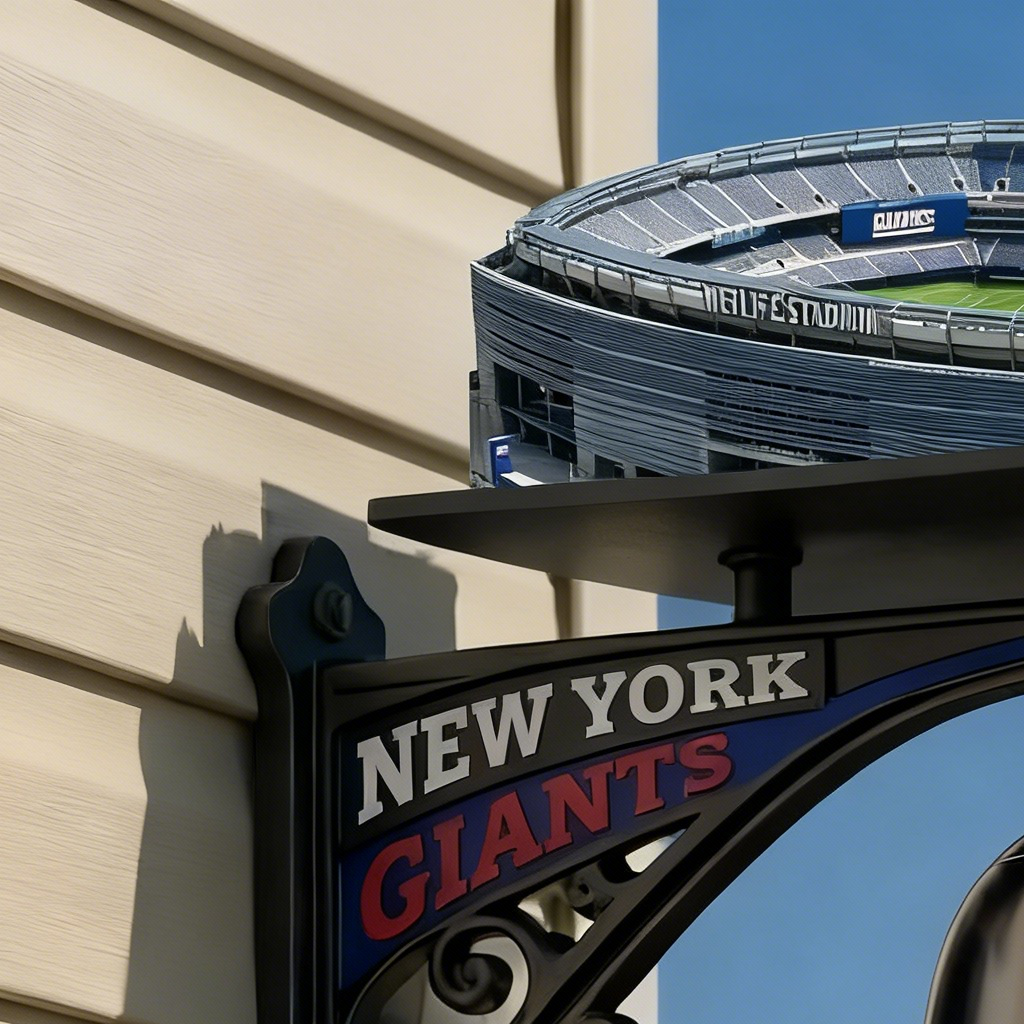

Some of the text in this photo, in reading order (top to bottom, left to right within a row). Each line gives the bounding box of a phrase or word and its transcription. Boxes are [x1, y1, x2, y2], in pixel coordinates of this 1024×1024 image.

[357, 651, 809, 825] NEW YORK
[360, 732, 734, 940] GIANTS
